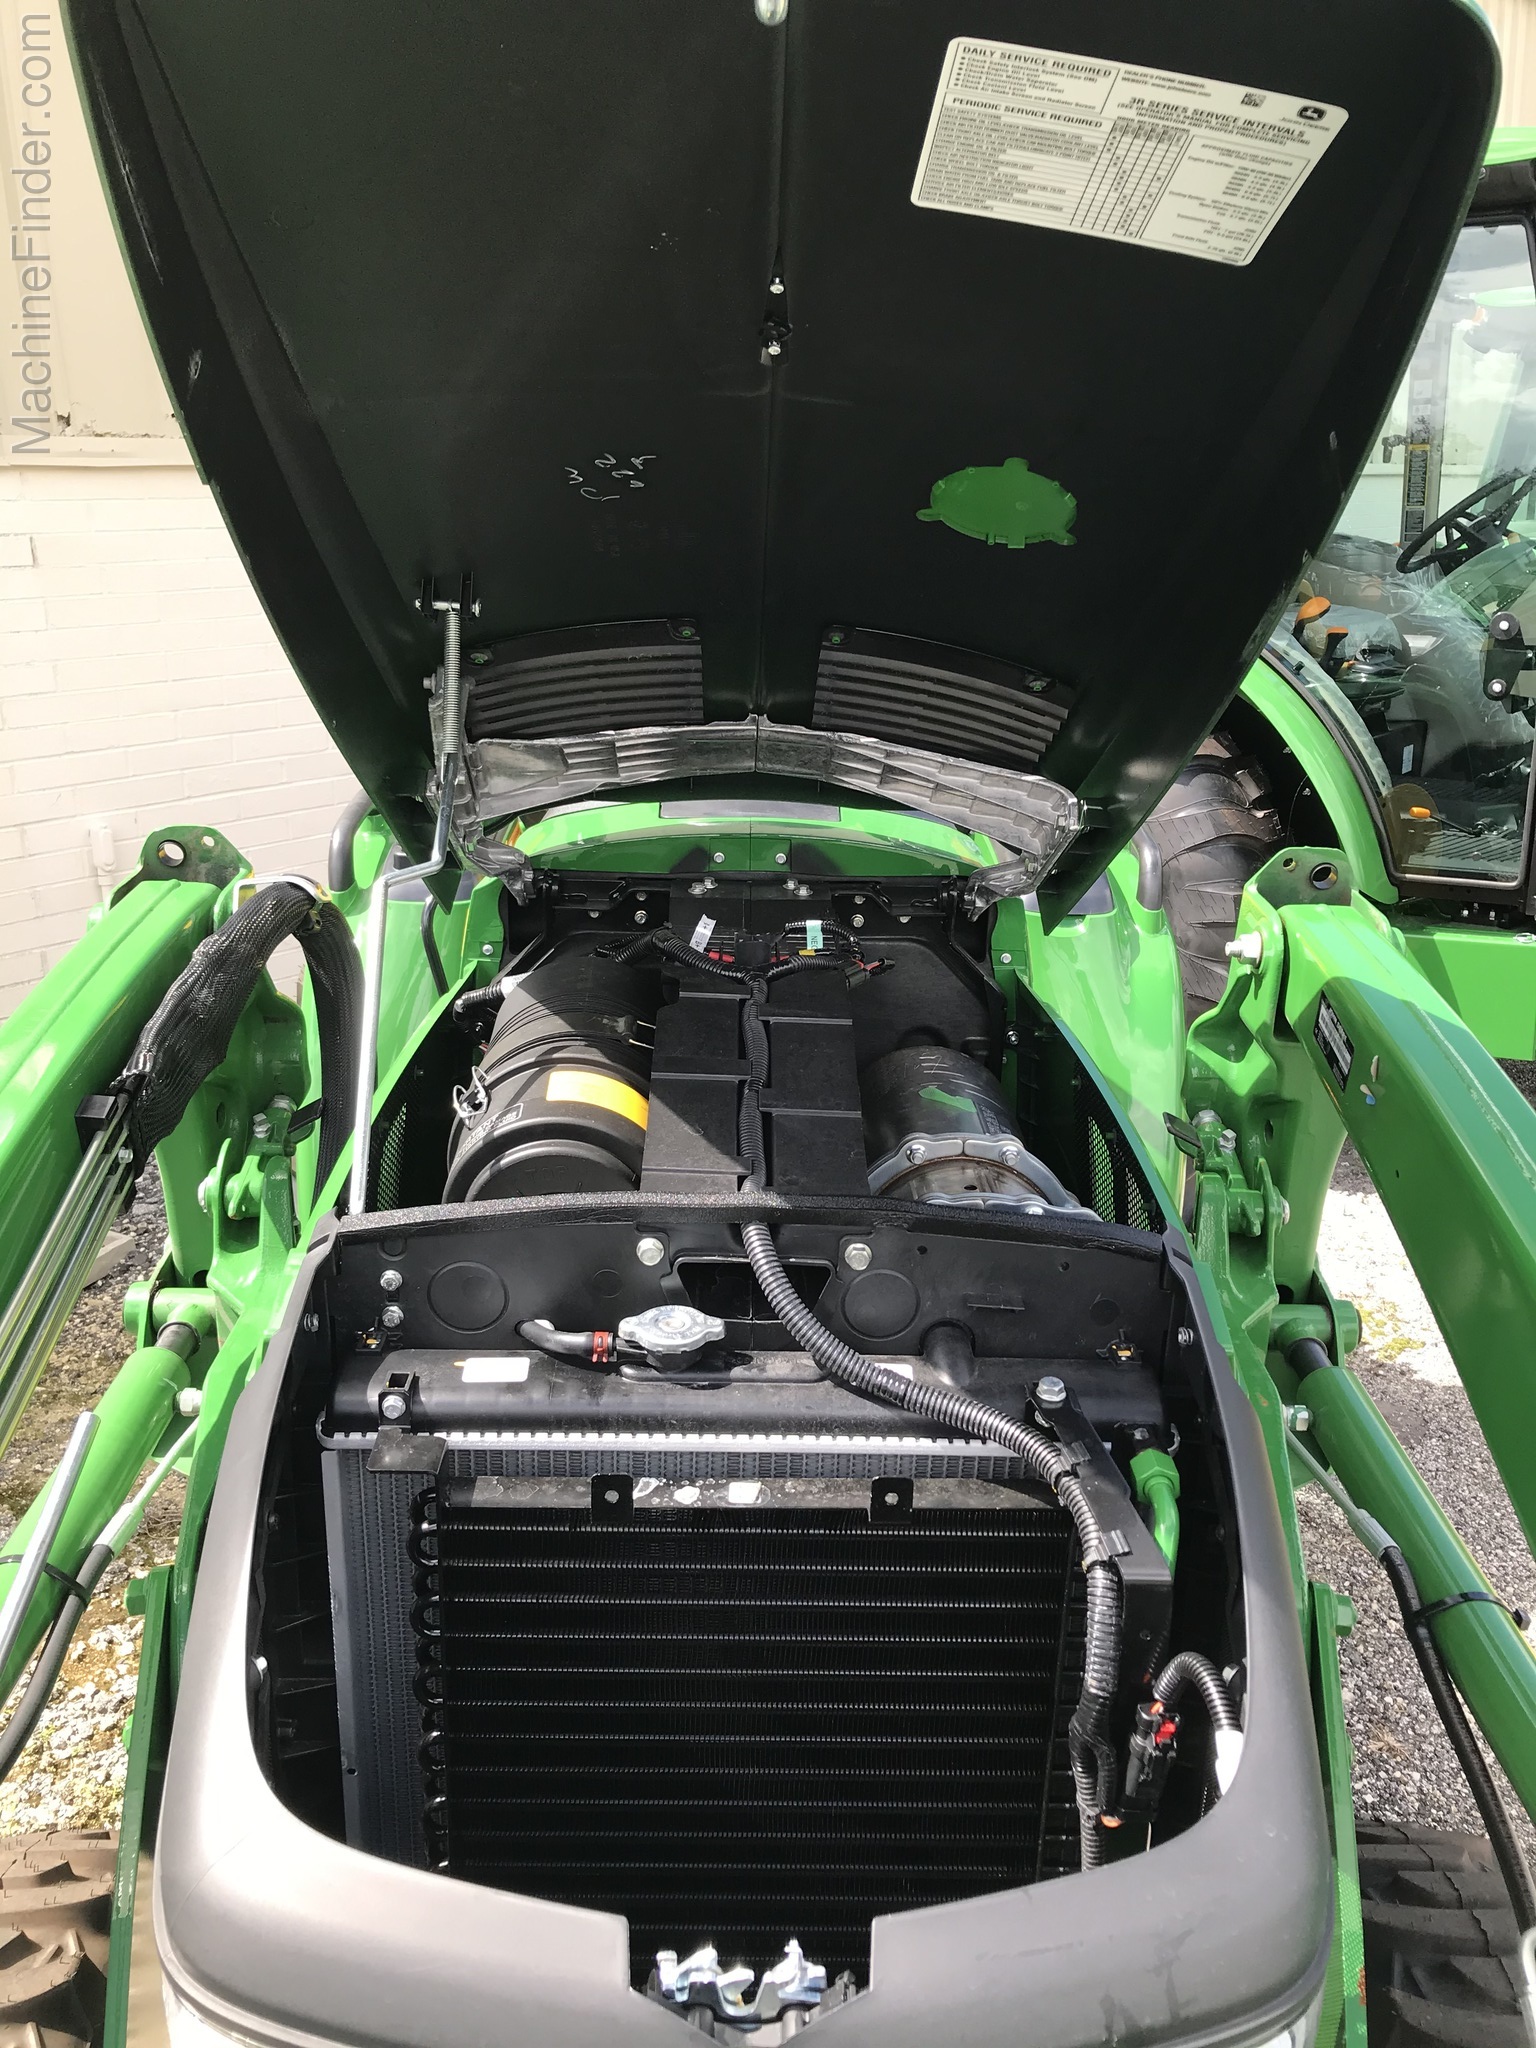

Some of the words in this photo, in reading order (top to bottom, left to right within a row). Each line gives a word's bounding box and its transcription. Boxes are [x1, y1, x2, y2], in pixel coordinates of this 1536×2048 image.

[962, 45, 996, 58] DAILY
[999, 51, 1048, 66] SERVICE
[1051, 60, 1112, 77] REQUIRED
[952, 96, 1001, 111] PERIODIC
[1003, 105, 1047, 119] SERVICE
[1048, 113, 1103, 128] REQUIRED
[1128, 96, 1146, 106] 3R
[1146, 100, 1190, 114] SERIES
[1190, 109, 1240, 124] SERVICE
[1240, 119, 1307, 137] INTERVALS
